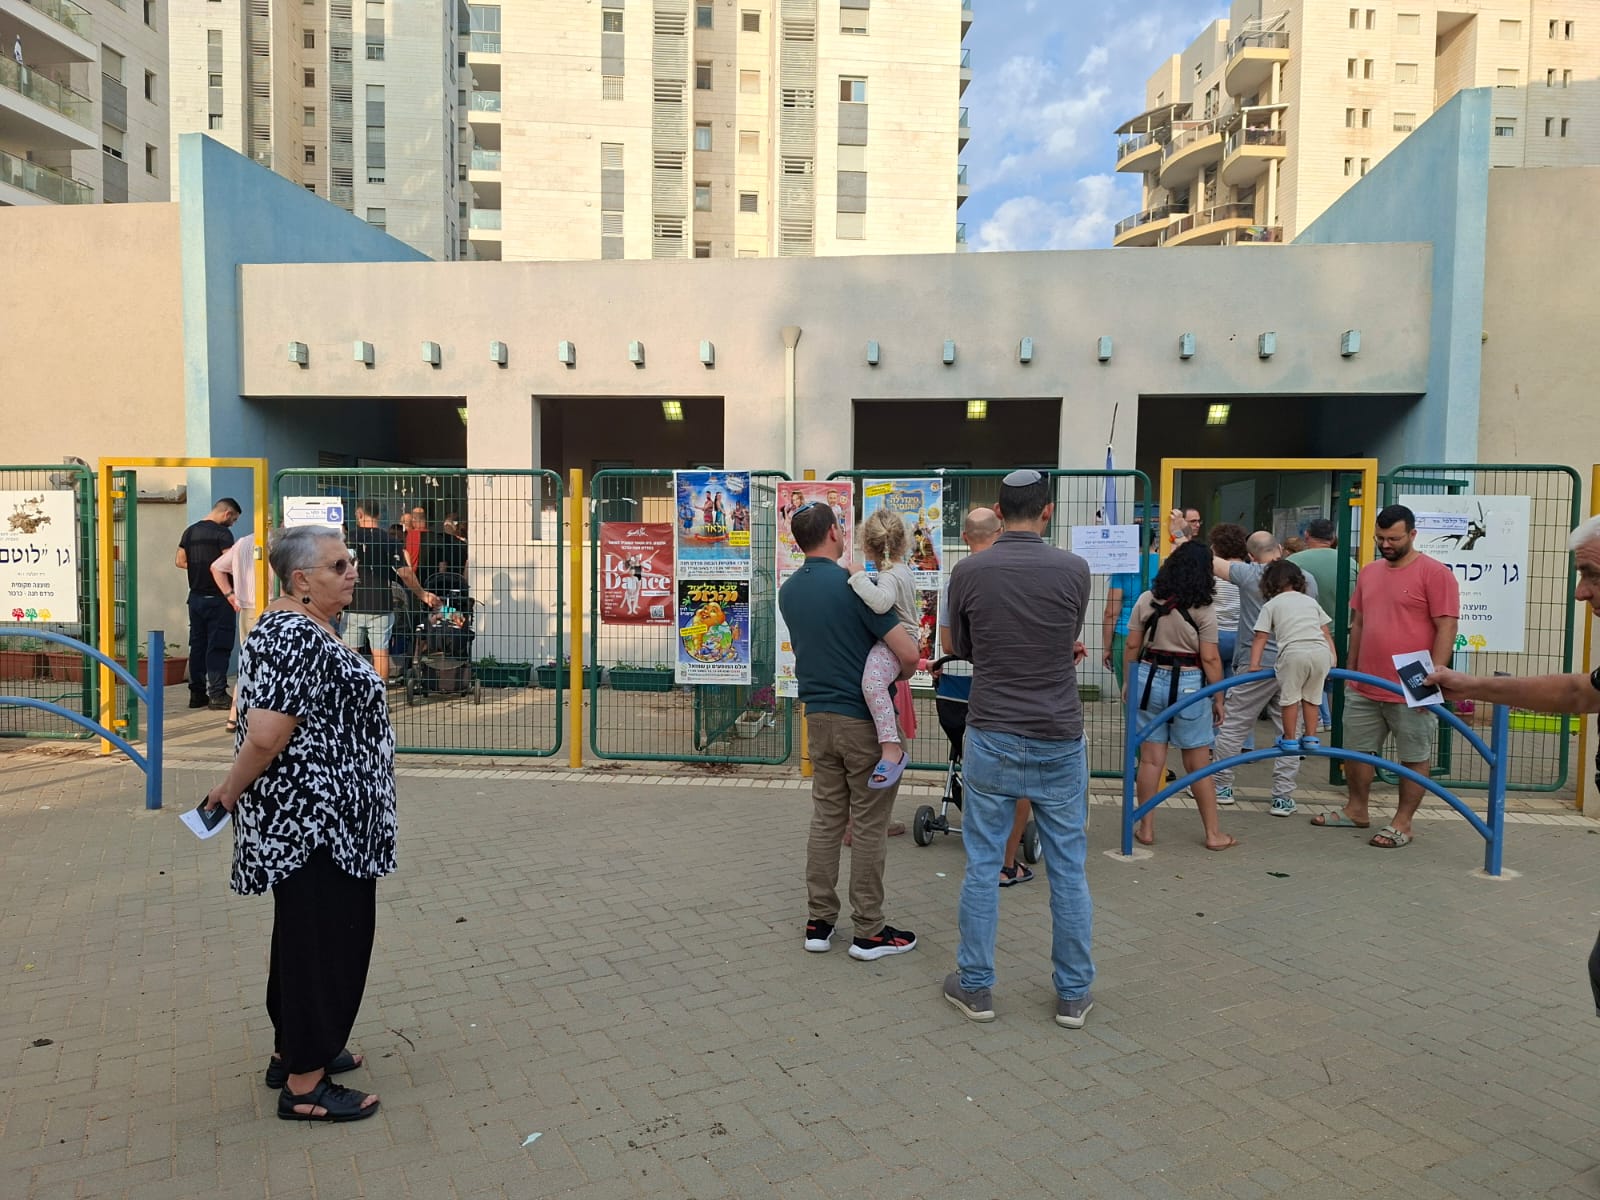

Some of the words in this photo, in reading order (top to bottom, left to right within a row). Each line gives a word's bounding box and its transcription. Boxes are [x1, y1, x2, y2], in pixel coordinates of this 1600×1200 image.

[57, 548, 71, 567] גן
[604, 572, 671, 590] Dance
[1444, 563, 1493, 582] "כר
[1502, 562, 1520, 585] גן
[11, 582, 32, 590] מקומית
[1462, 603, 1488, 611] מועצה
[1471, 614, 1493, 622] פרדס
